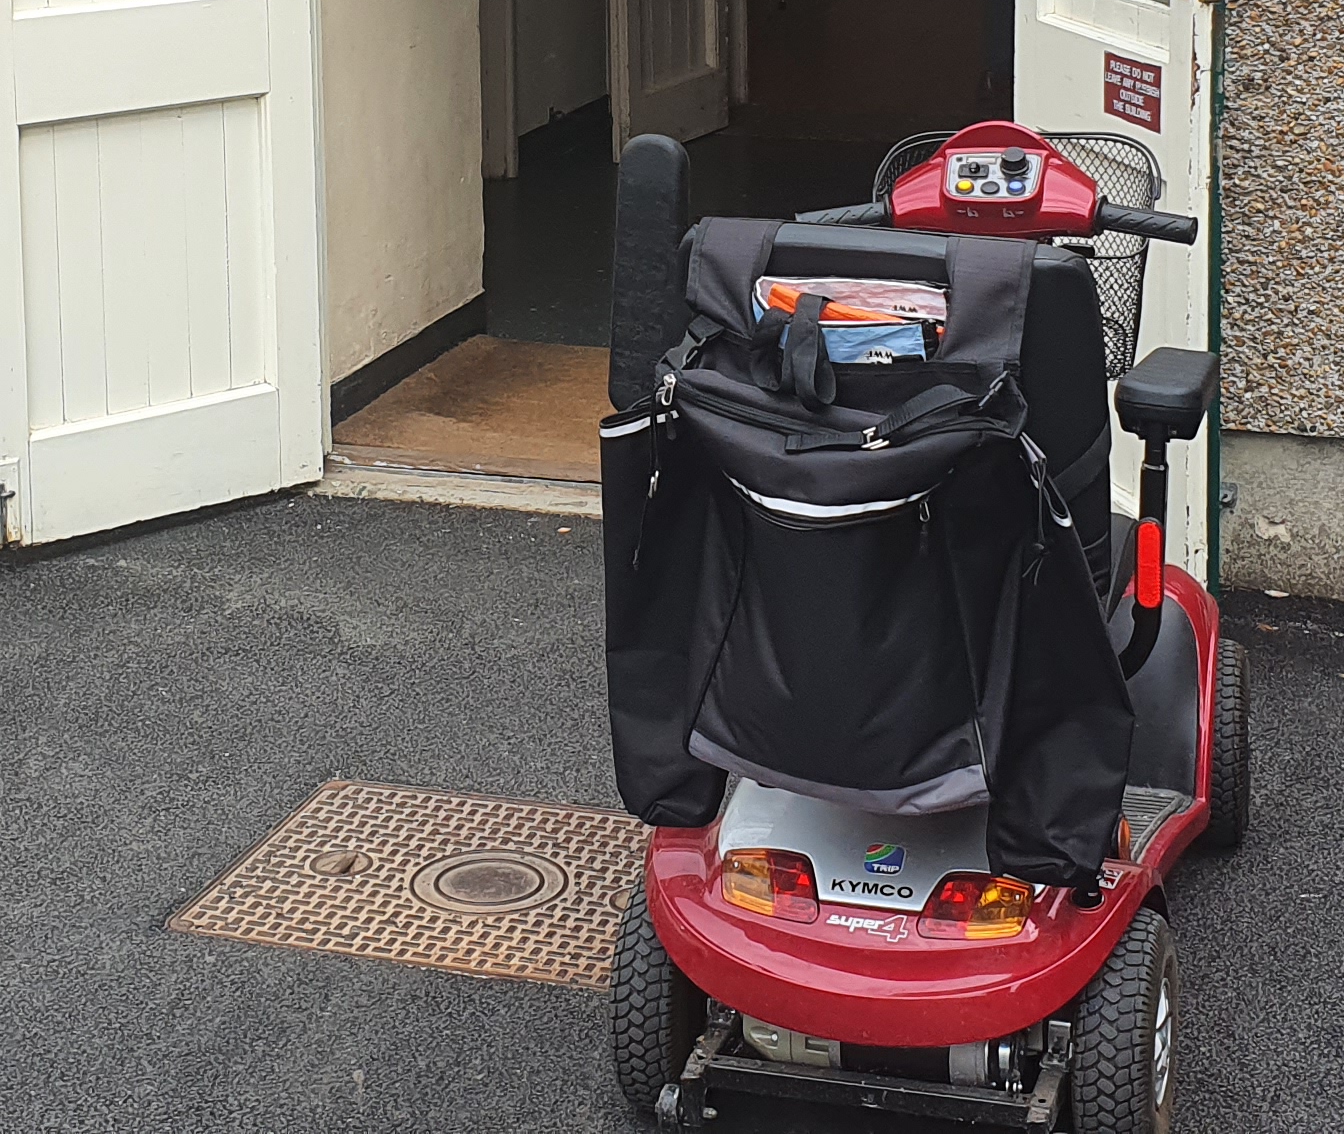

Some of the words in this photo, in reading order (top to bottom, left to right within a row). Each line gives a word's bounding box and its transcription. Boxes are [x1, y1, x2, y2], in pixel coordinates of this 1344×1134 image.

[1110, 60, 1131, 76] PLEASE
[1132, 67, 1141, 79] DO
[872, 863, 900, 873] TRIP
[831, 878, 914, 899] KYMCO
